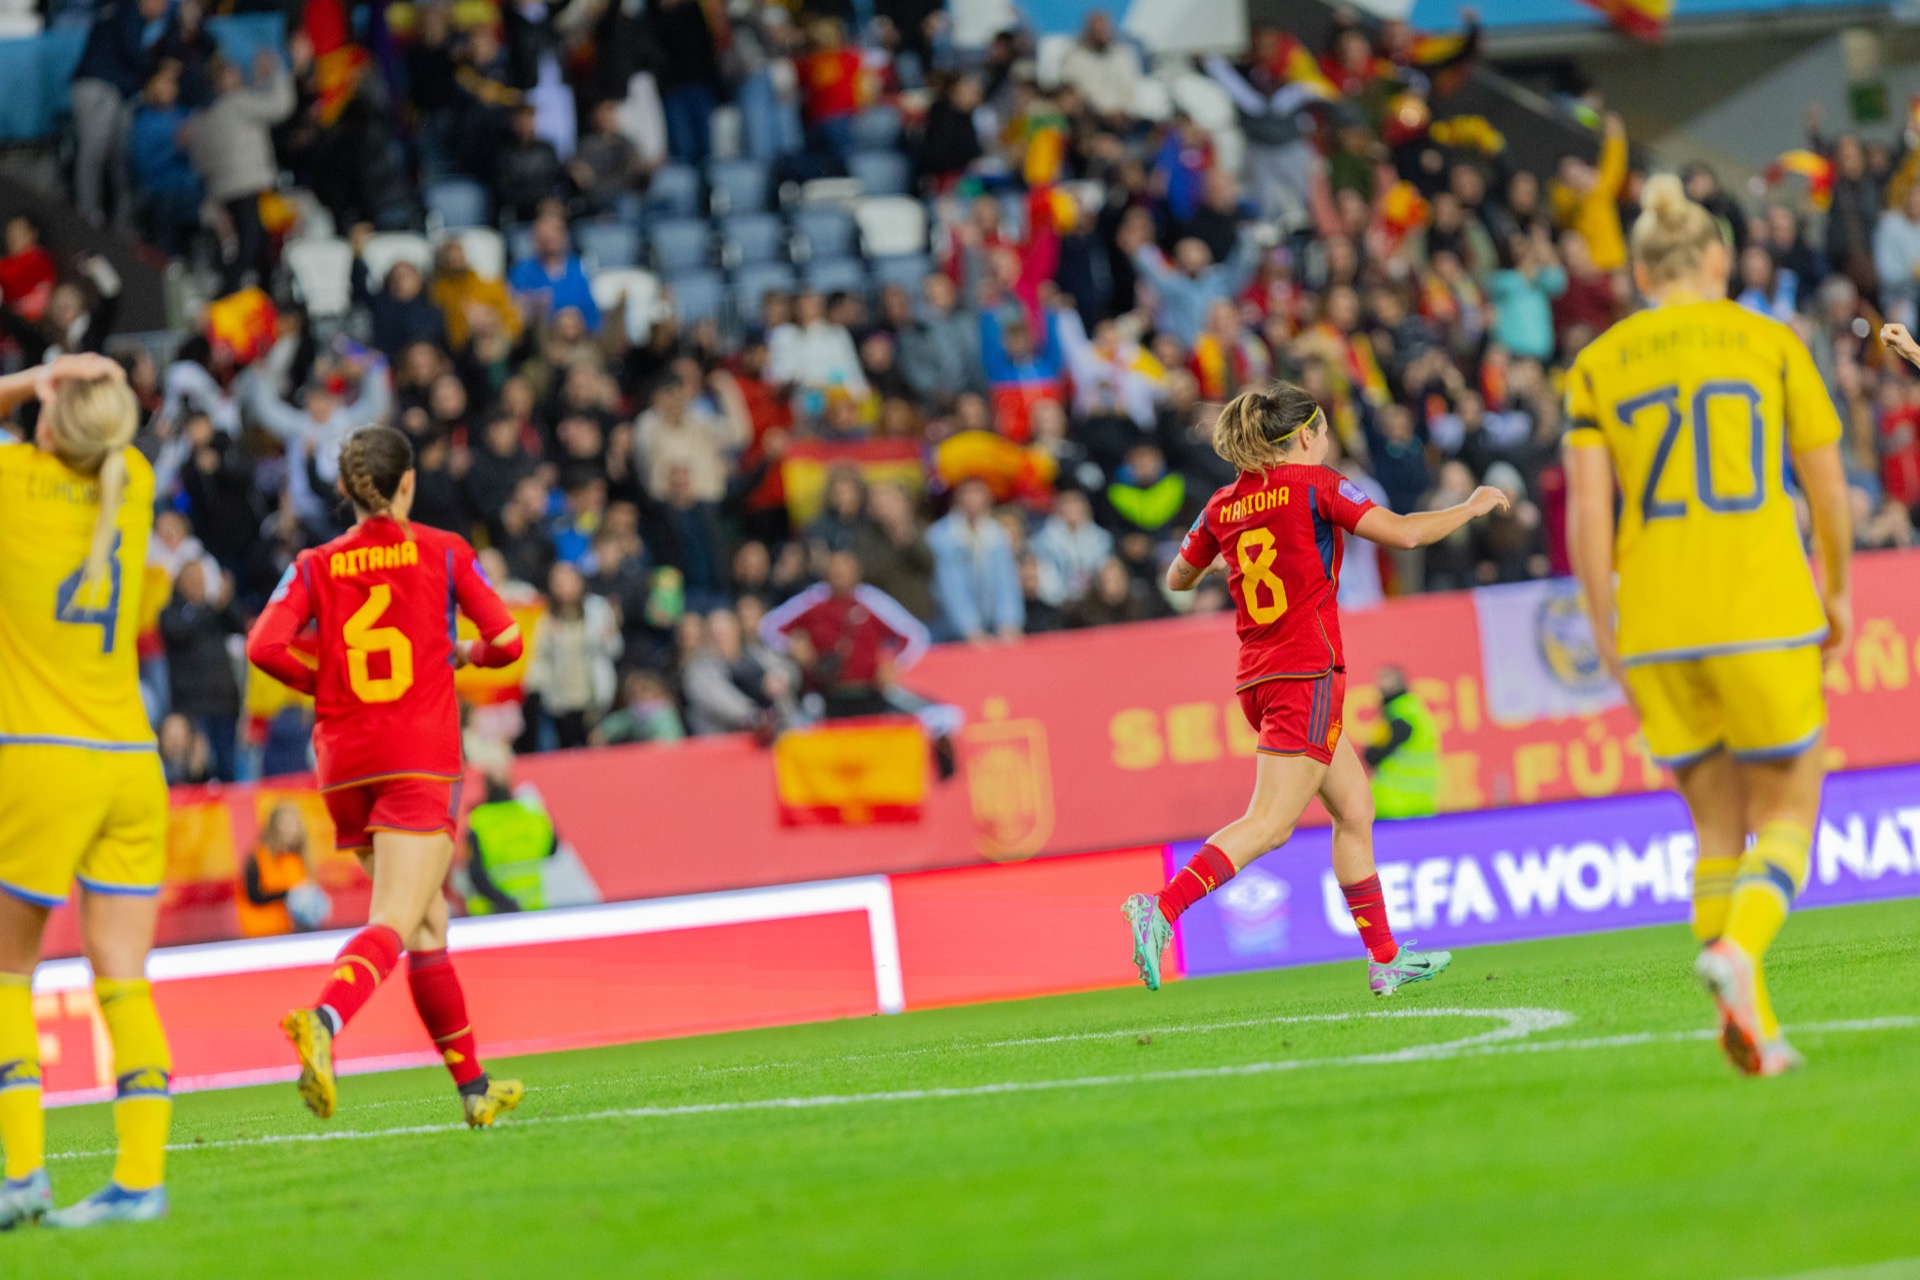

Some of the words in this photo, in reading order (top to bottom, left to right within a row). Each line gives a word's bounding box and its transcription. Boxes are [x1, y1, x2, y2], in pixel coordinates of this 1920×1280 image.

[1219, 486, 1290, 524] MARIONA
[1616, 380, 1765, 524] 20
[56, 530, 122, 654] 4
[330, 541, 418, 578] AITANA
[1237, 527, 1288, 625] 8
[343, 583, 414, 704] 6
[1321, 855, 1499, 937] UEFA
[1492, 830, 1696, 918] WOME
